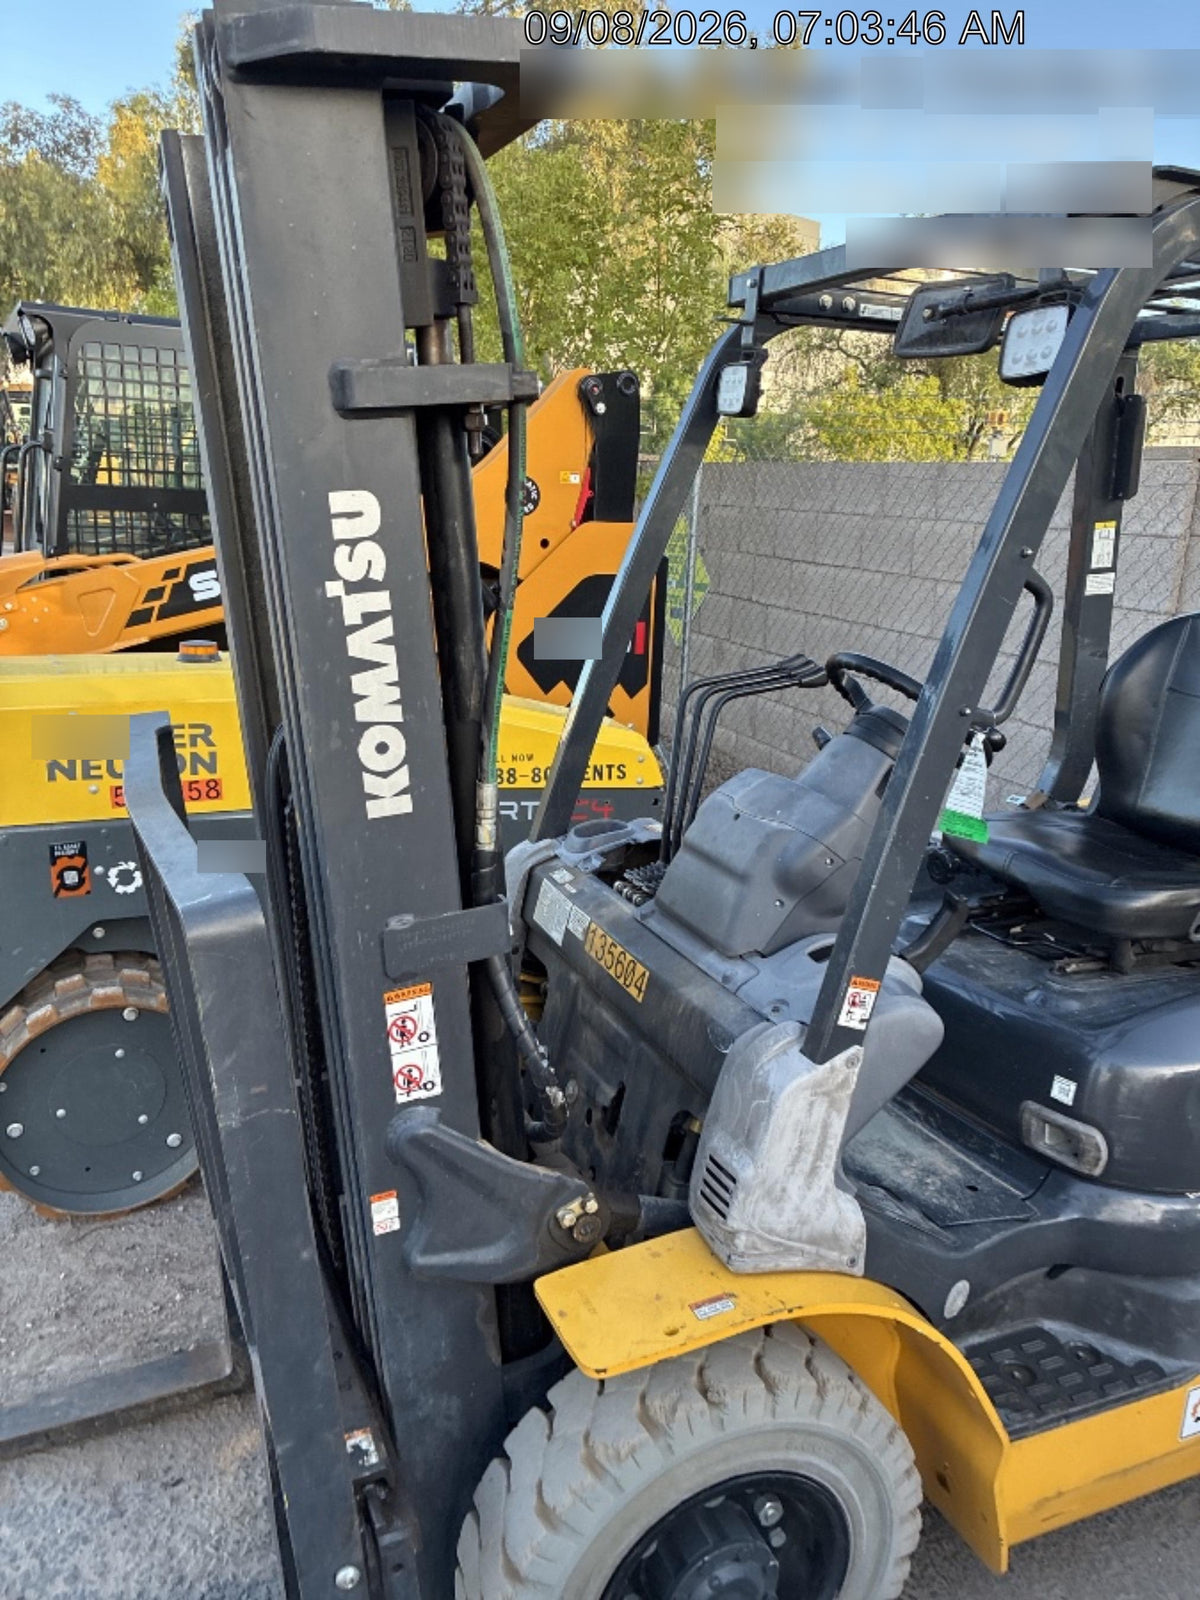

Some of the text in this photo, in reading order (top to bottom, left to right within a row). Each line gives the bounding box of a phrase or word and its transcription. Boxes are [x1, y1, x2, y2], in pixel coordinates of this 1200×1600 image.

[324, 489, 414, 820] KOMATSU
[511, 753, 534, 763] NOW
[588, 927, 647, 998] 135604
